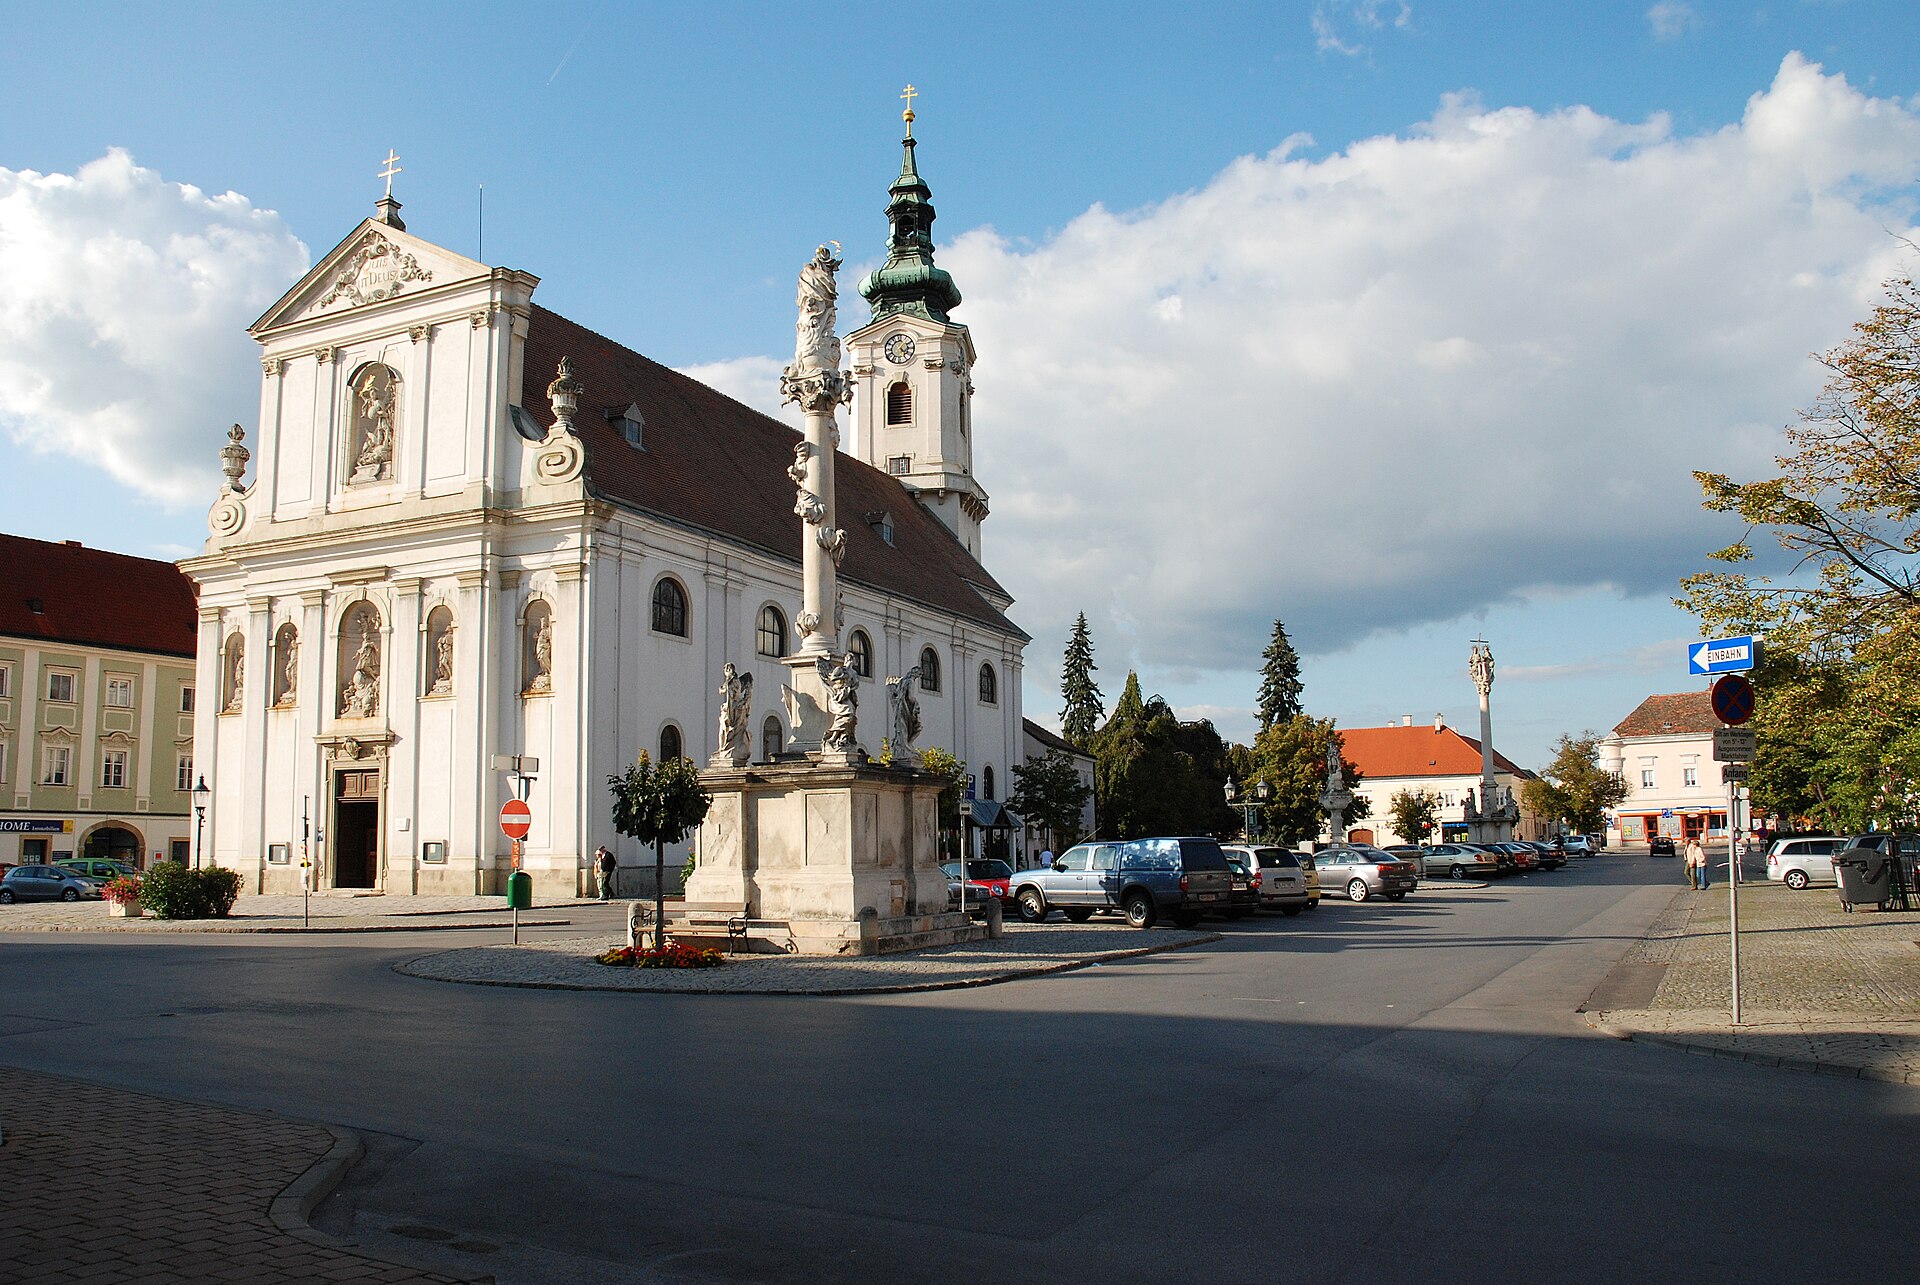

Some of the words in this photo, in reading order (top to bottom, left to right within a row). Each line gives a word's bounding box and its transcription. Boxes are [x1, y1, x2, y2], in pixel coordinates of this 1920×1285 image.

[369, 271, 398, 285] DEUS
[1707, 648, 1741, 662] EINBAHN
[1723, 768, 1748, 780] Anfang
[967, 776, 974, 788] P
